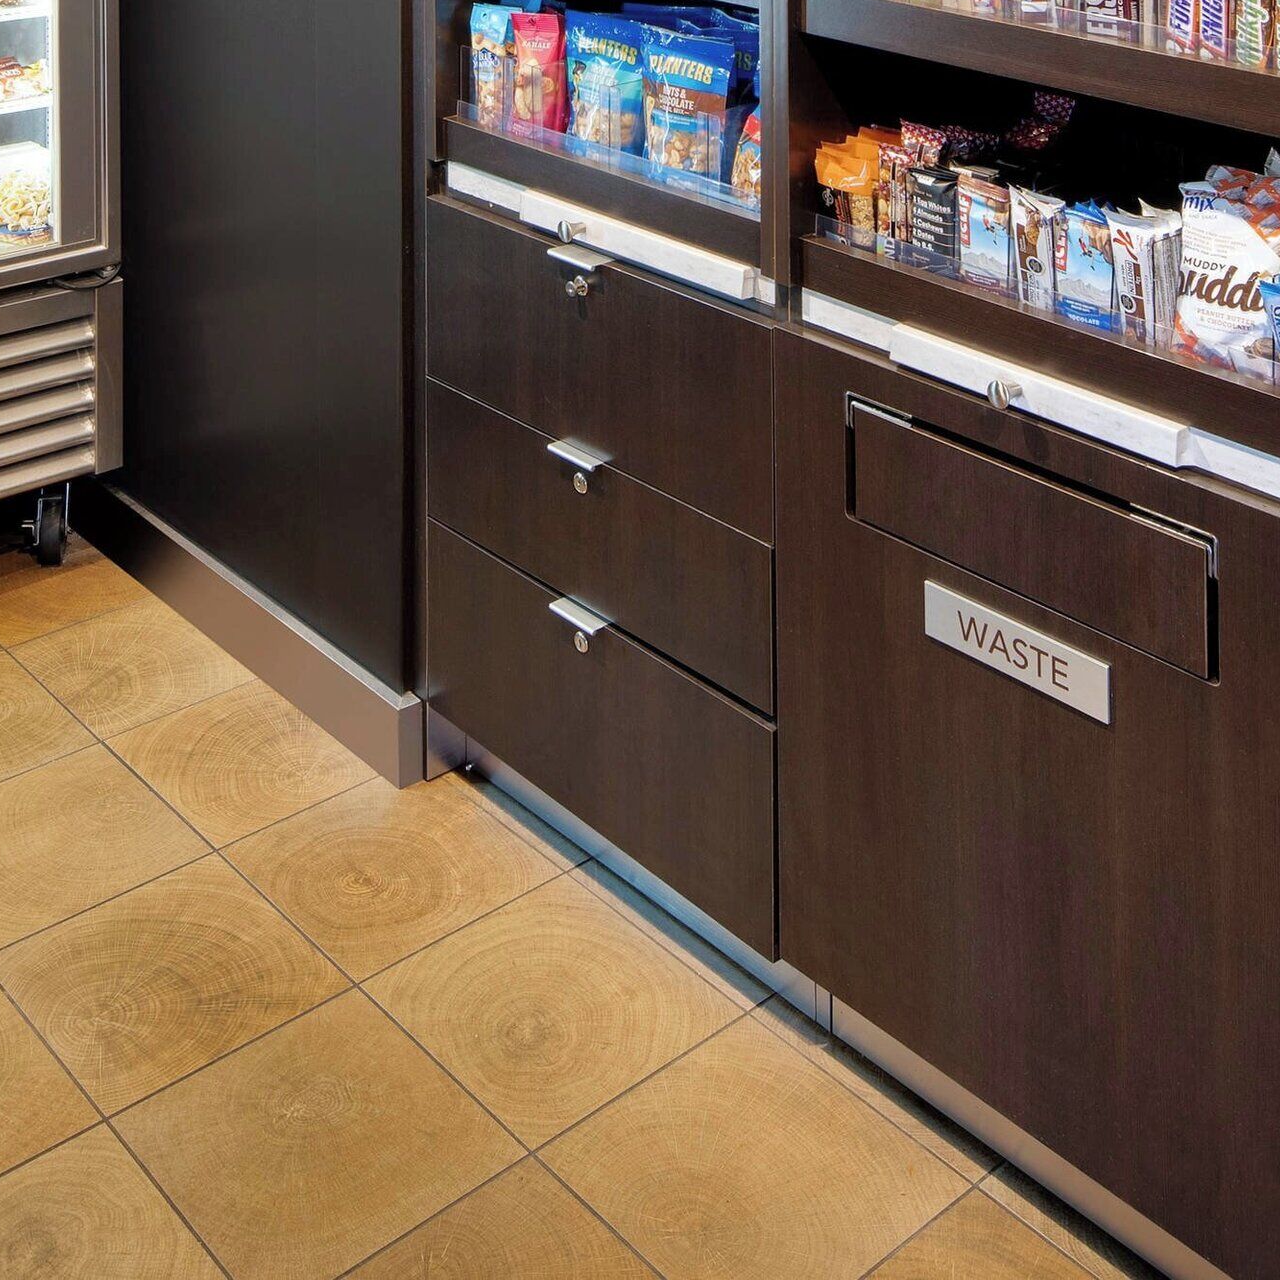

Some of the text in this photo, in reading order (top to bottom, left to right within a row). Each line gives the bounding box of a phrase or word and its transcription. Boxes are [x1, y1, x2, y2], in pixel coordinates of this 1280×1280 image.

[650, 54, 714, 85] PLANTERS
[659, 94, 694, 110] CHOCOLATE
[959, 194, 970, 235] CLIF
[1184, 256, 1227, 271] MUDDY
[957, 610, 1070, 691] WASTE
